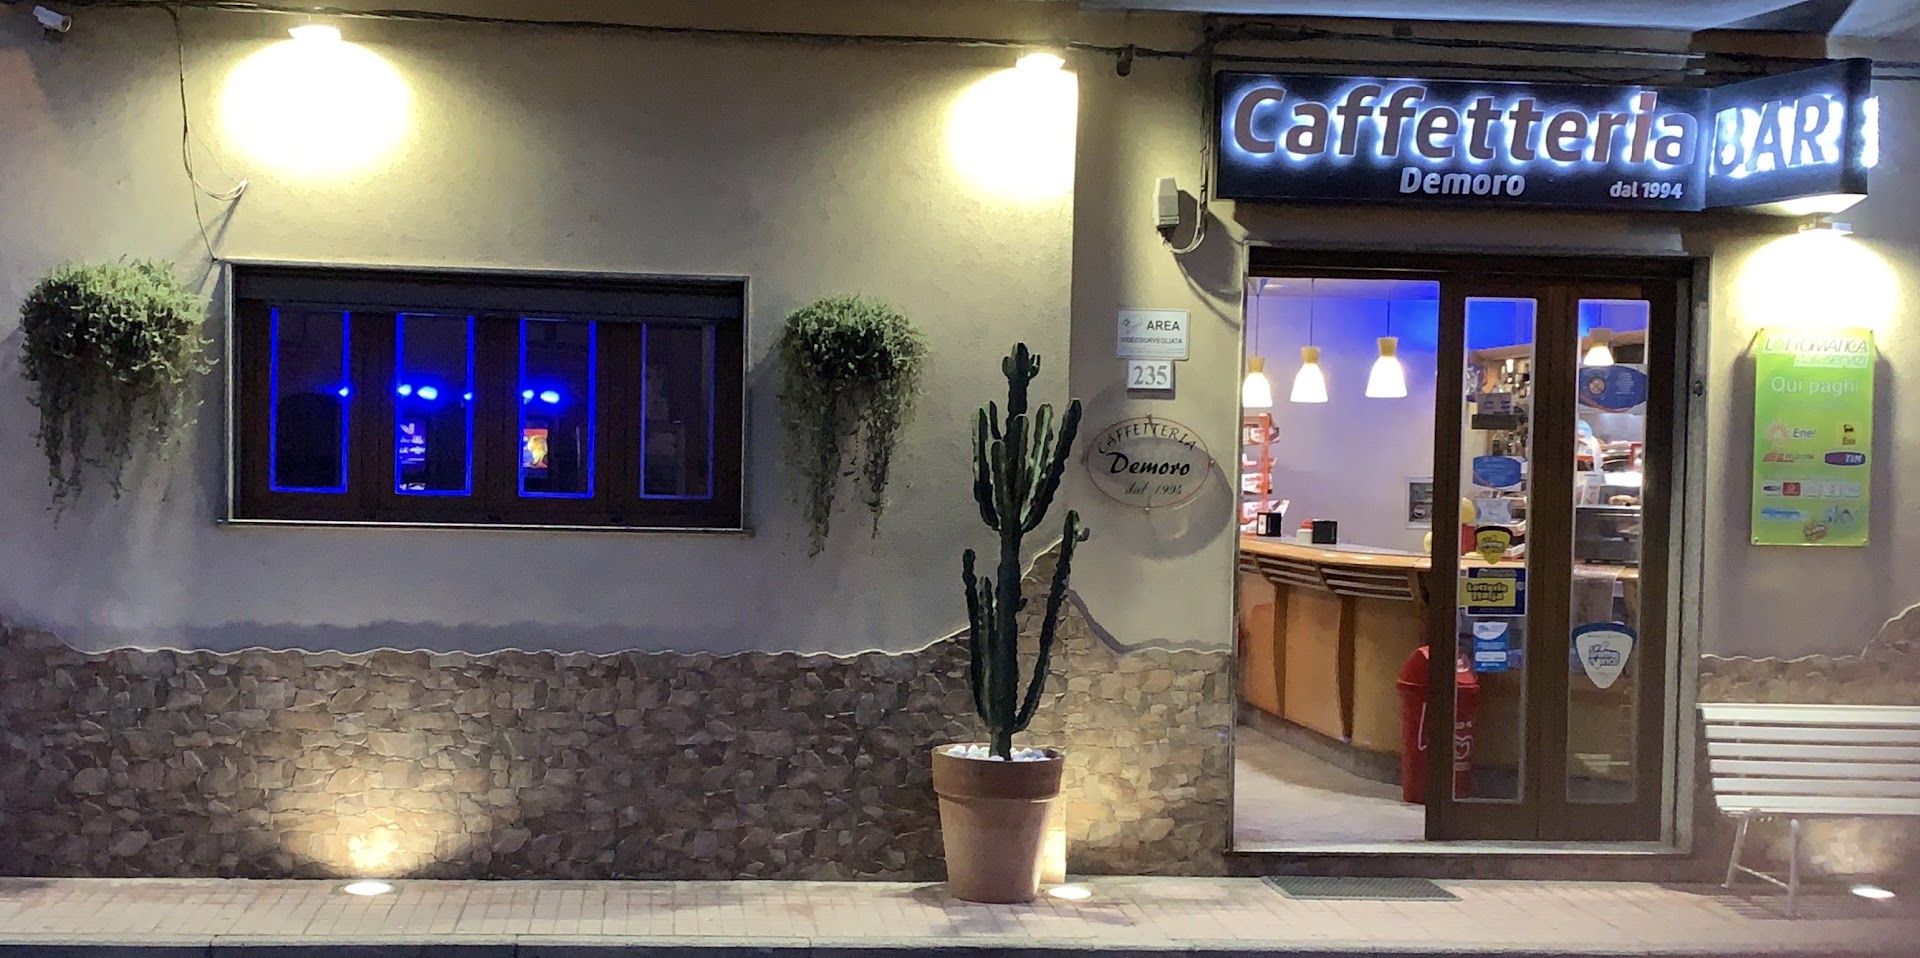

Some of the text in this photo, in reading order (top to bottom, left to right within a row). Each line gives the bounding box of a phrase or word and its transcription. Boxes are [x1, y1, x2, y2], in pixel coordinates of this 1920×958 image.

[1234, 84, 1698, 166] Caffetteria
[1709, 93, 1833, 177] BAR
[1399, 166, 1526, 197] Demoro
[1610, 180, 1683, 200] dal 1994
[1146, 320, 1181, 331] AREA
[1764, 338, 1868, 353] LTTOMATICA
[1133, 365, 1168, 386] 235
[1771, 376, 1859, 397] Qui paghi
[1098, 422, 1197, 454] CAFFETTERIA
[1106, 451, 1191, 476] Demoro
[1845, 454, 1863, 464] TIM
[1125, 481, 1149, 495] dal
